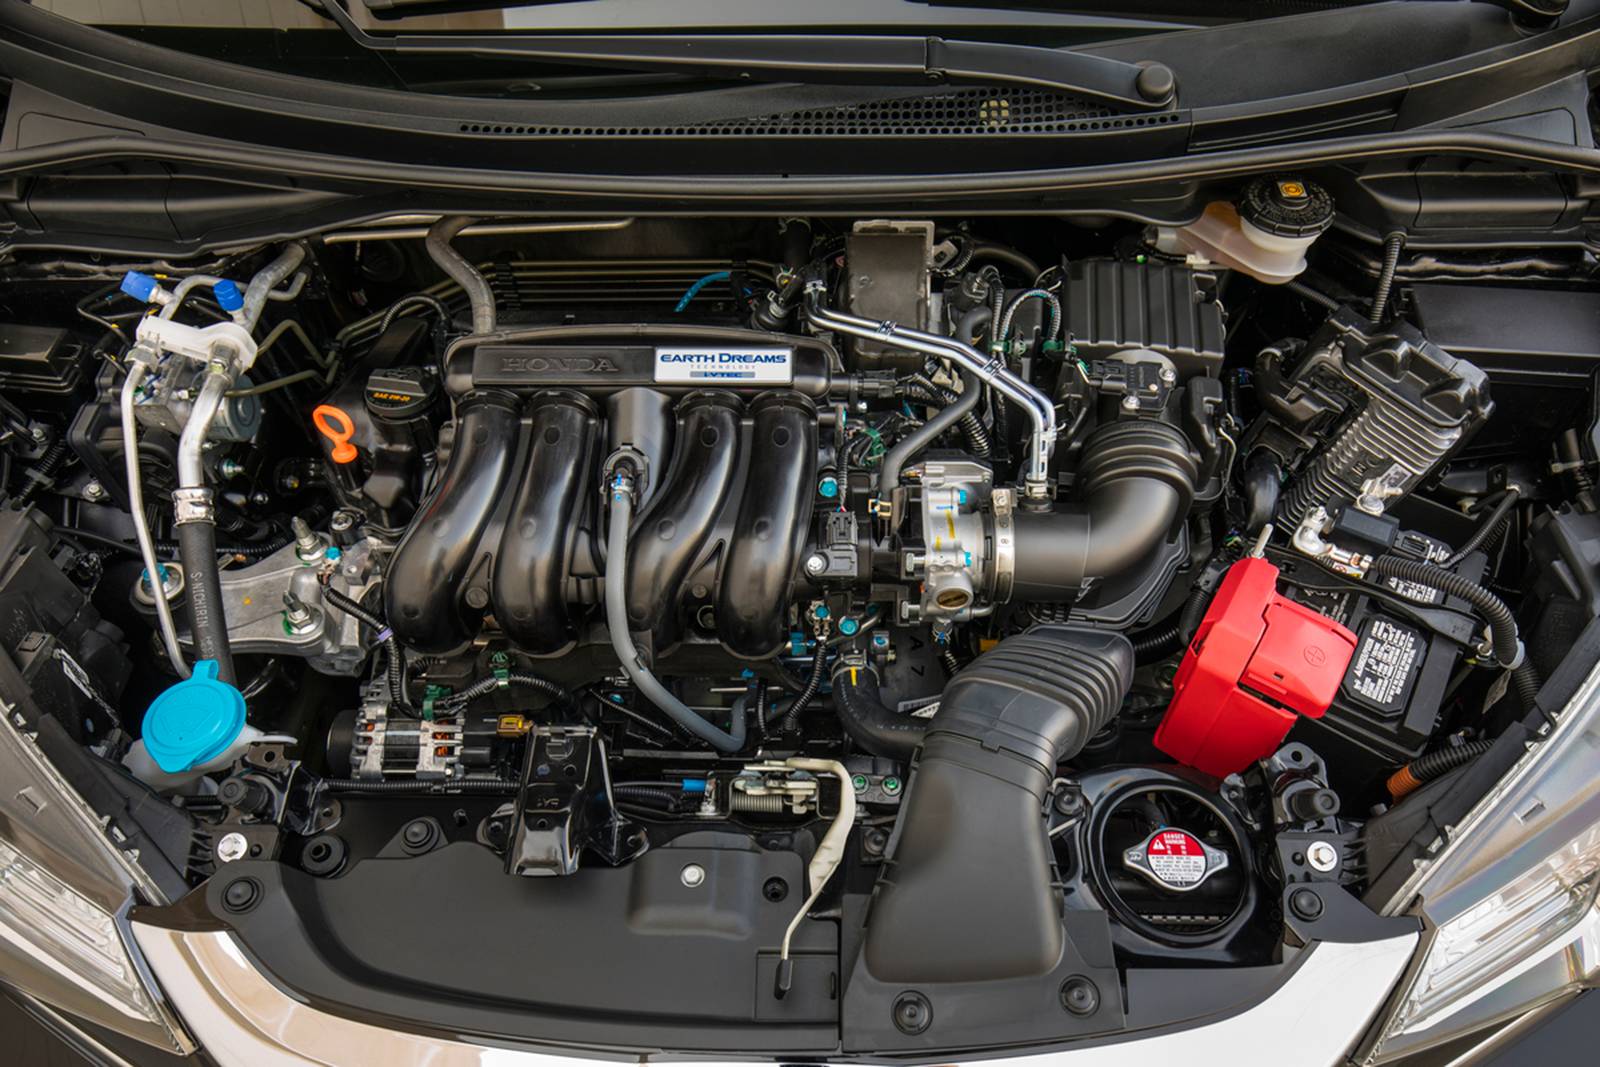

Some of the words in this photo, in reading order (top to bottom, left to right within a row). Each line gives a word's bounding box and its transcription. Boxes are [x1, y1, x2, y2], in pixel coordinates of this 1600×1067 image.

[660, 353, 715, 363] EARTH
[718, 352, 787, 363] DREAMS
[502, 358, 619, 372] HONDA
